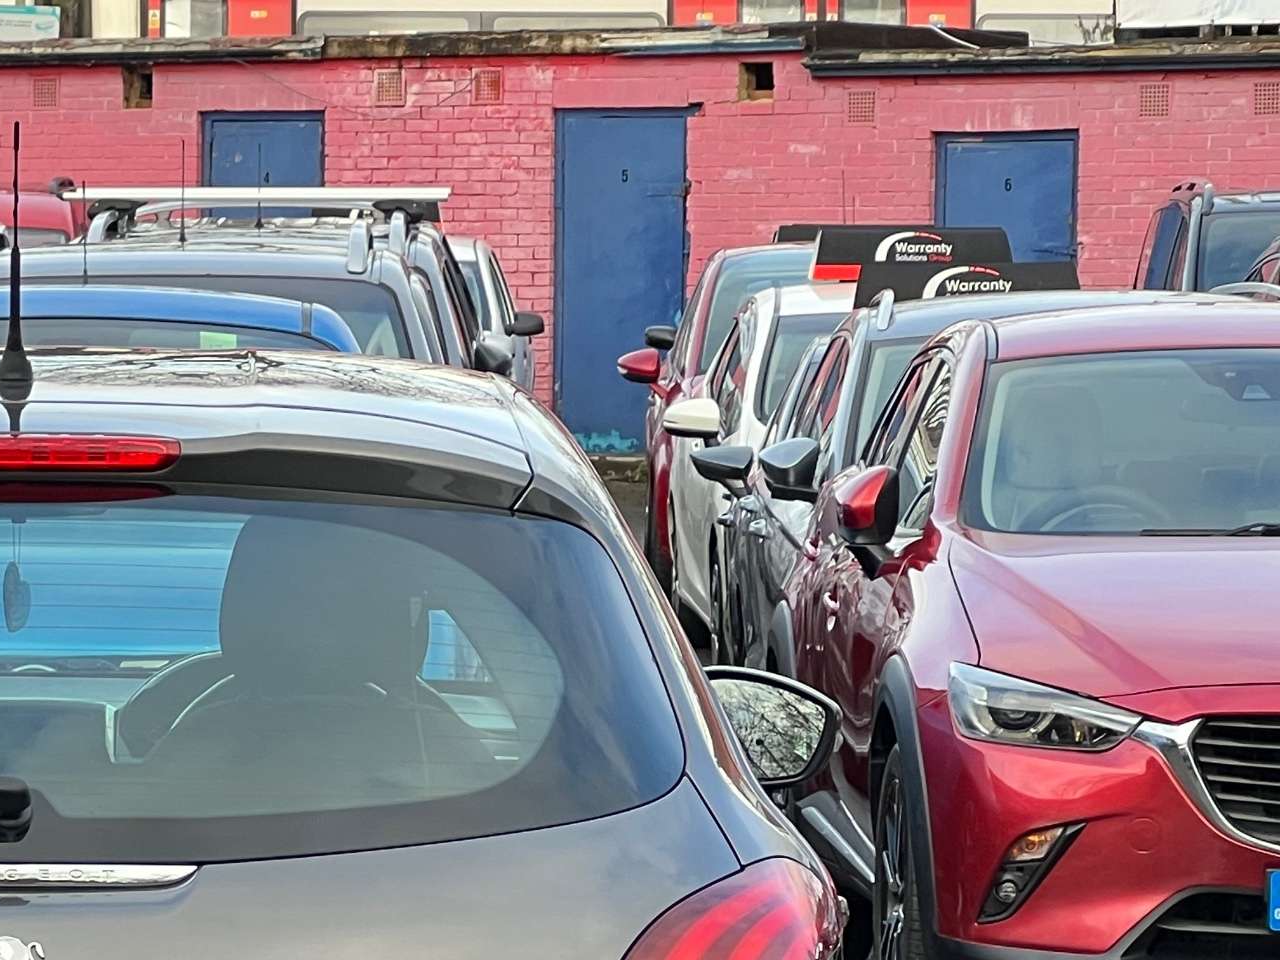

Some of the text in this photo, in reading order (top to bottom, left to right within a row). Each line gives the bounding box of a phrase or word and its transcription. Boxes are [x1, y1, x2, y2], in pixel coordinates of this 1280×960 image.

[264, 171, 270, 184] 4
[622, 169, 629, 183] 5
[1005, 178, 1012, 192] 6
[895, 242, 953, 255] Warranty
[895, 254, 928, 262] Solutions
[945, 279, 1013, 293] Warranty
